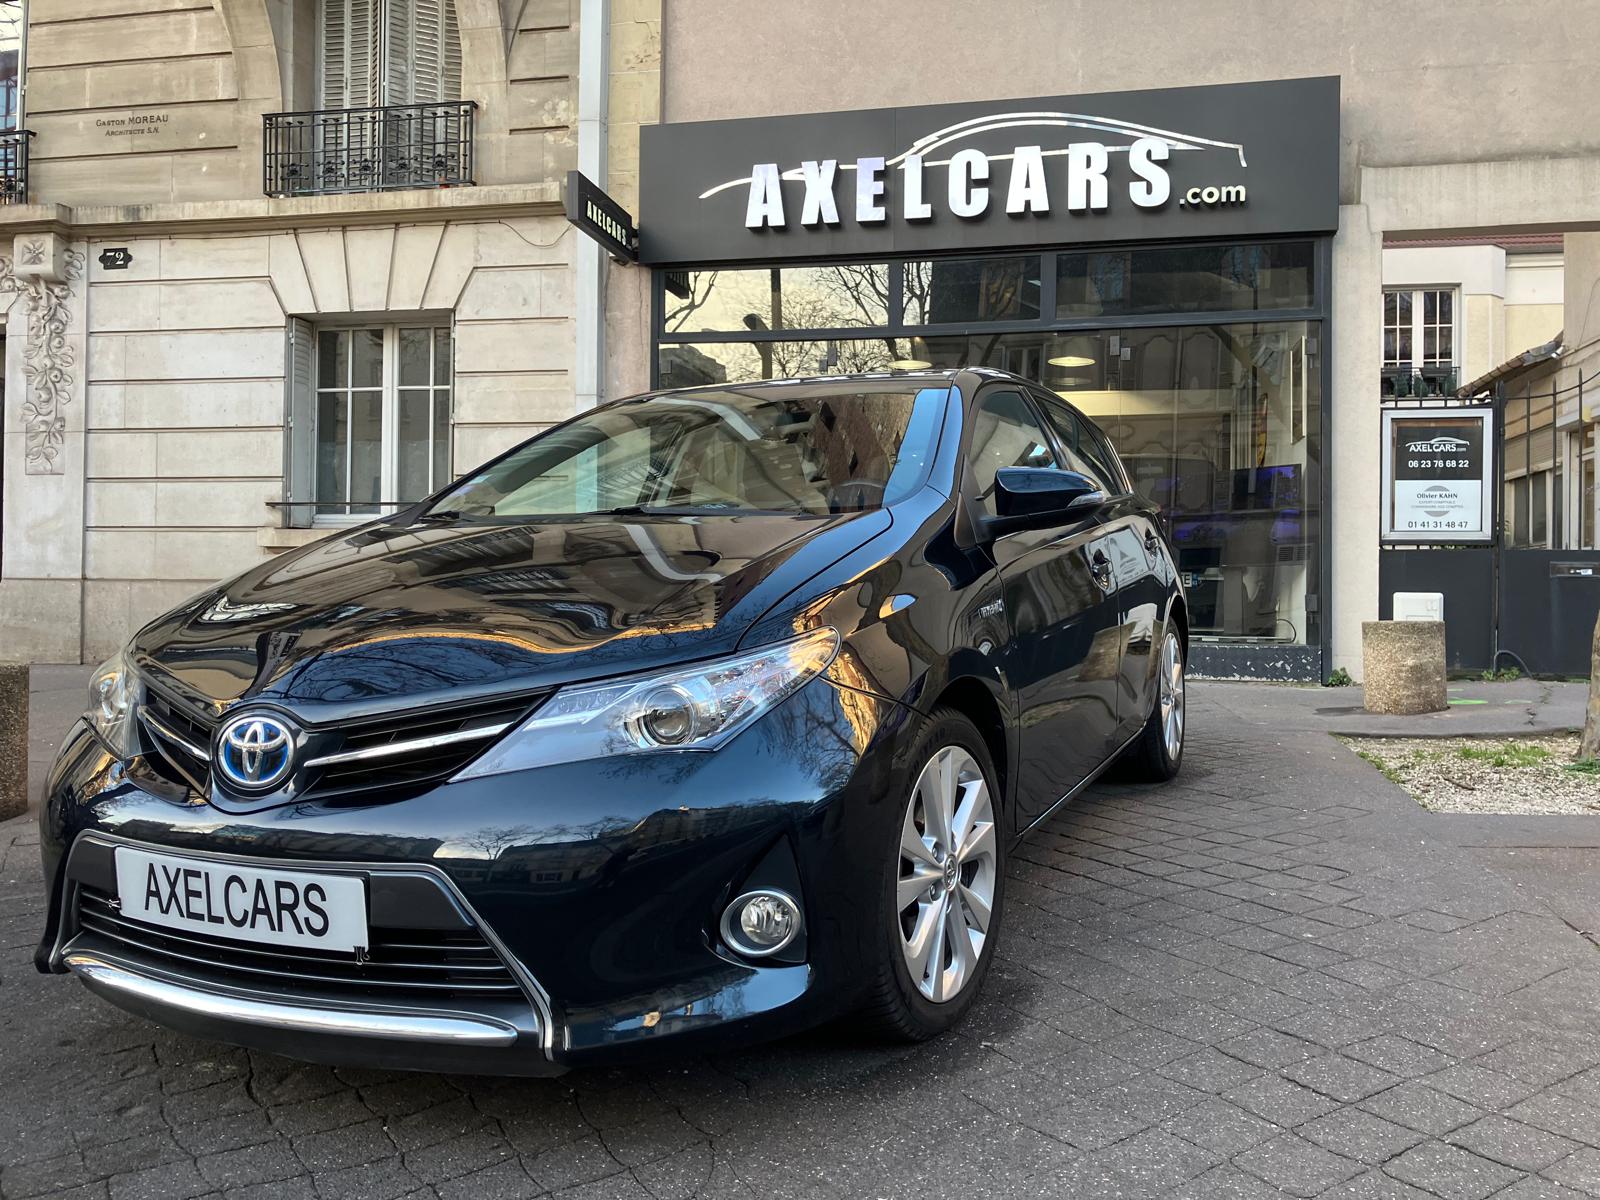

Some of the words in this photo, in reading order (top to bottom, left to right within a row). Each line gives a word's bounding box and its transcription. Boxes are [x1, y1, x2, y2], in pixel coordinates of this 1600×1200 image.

[128, 115, 169, 125] MOREAU
[586, 200, 627, 246] AXELCARS
[106, 251, 124, 265] 72
[1408, 460, 1419, 468] 06
[1420, 460, 1431, 468] 23
[1433, 460, 1444, 468] 76
[1445, 460, 1457, 468] 68
[1458, 460, 1469, 468] 22
[144, 862, 329, 937] AXELCARS
